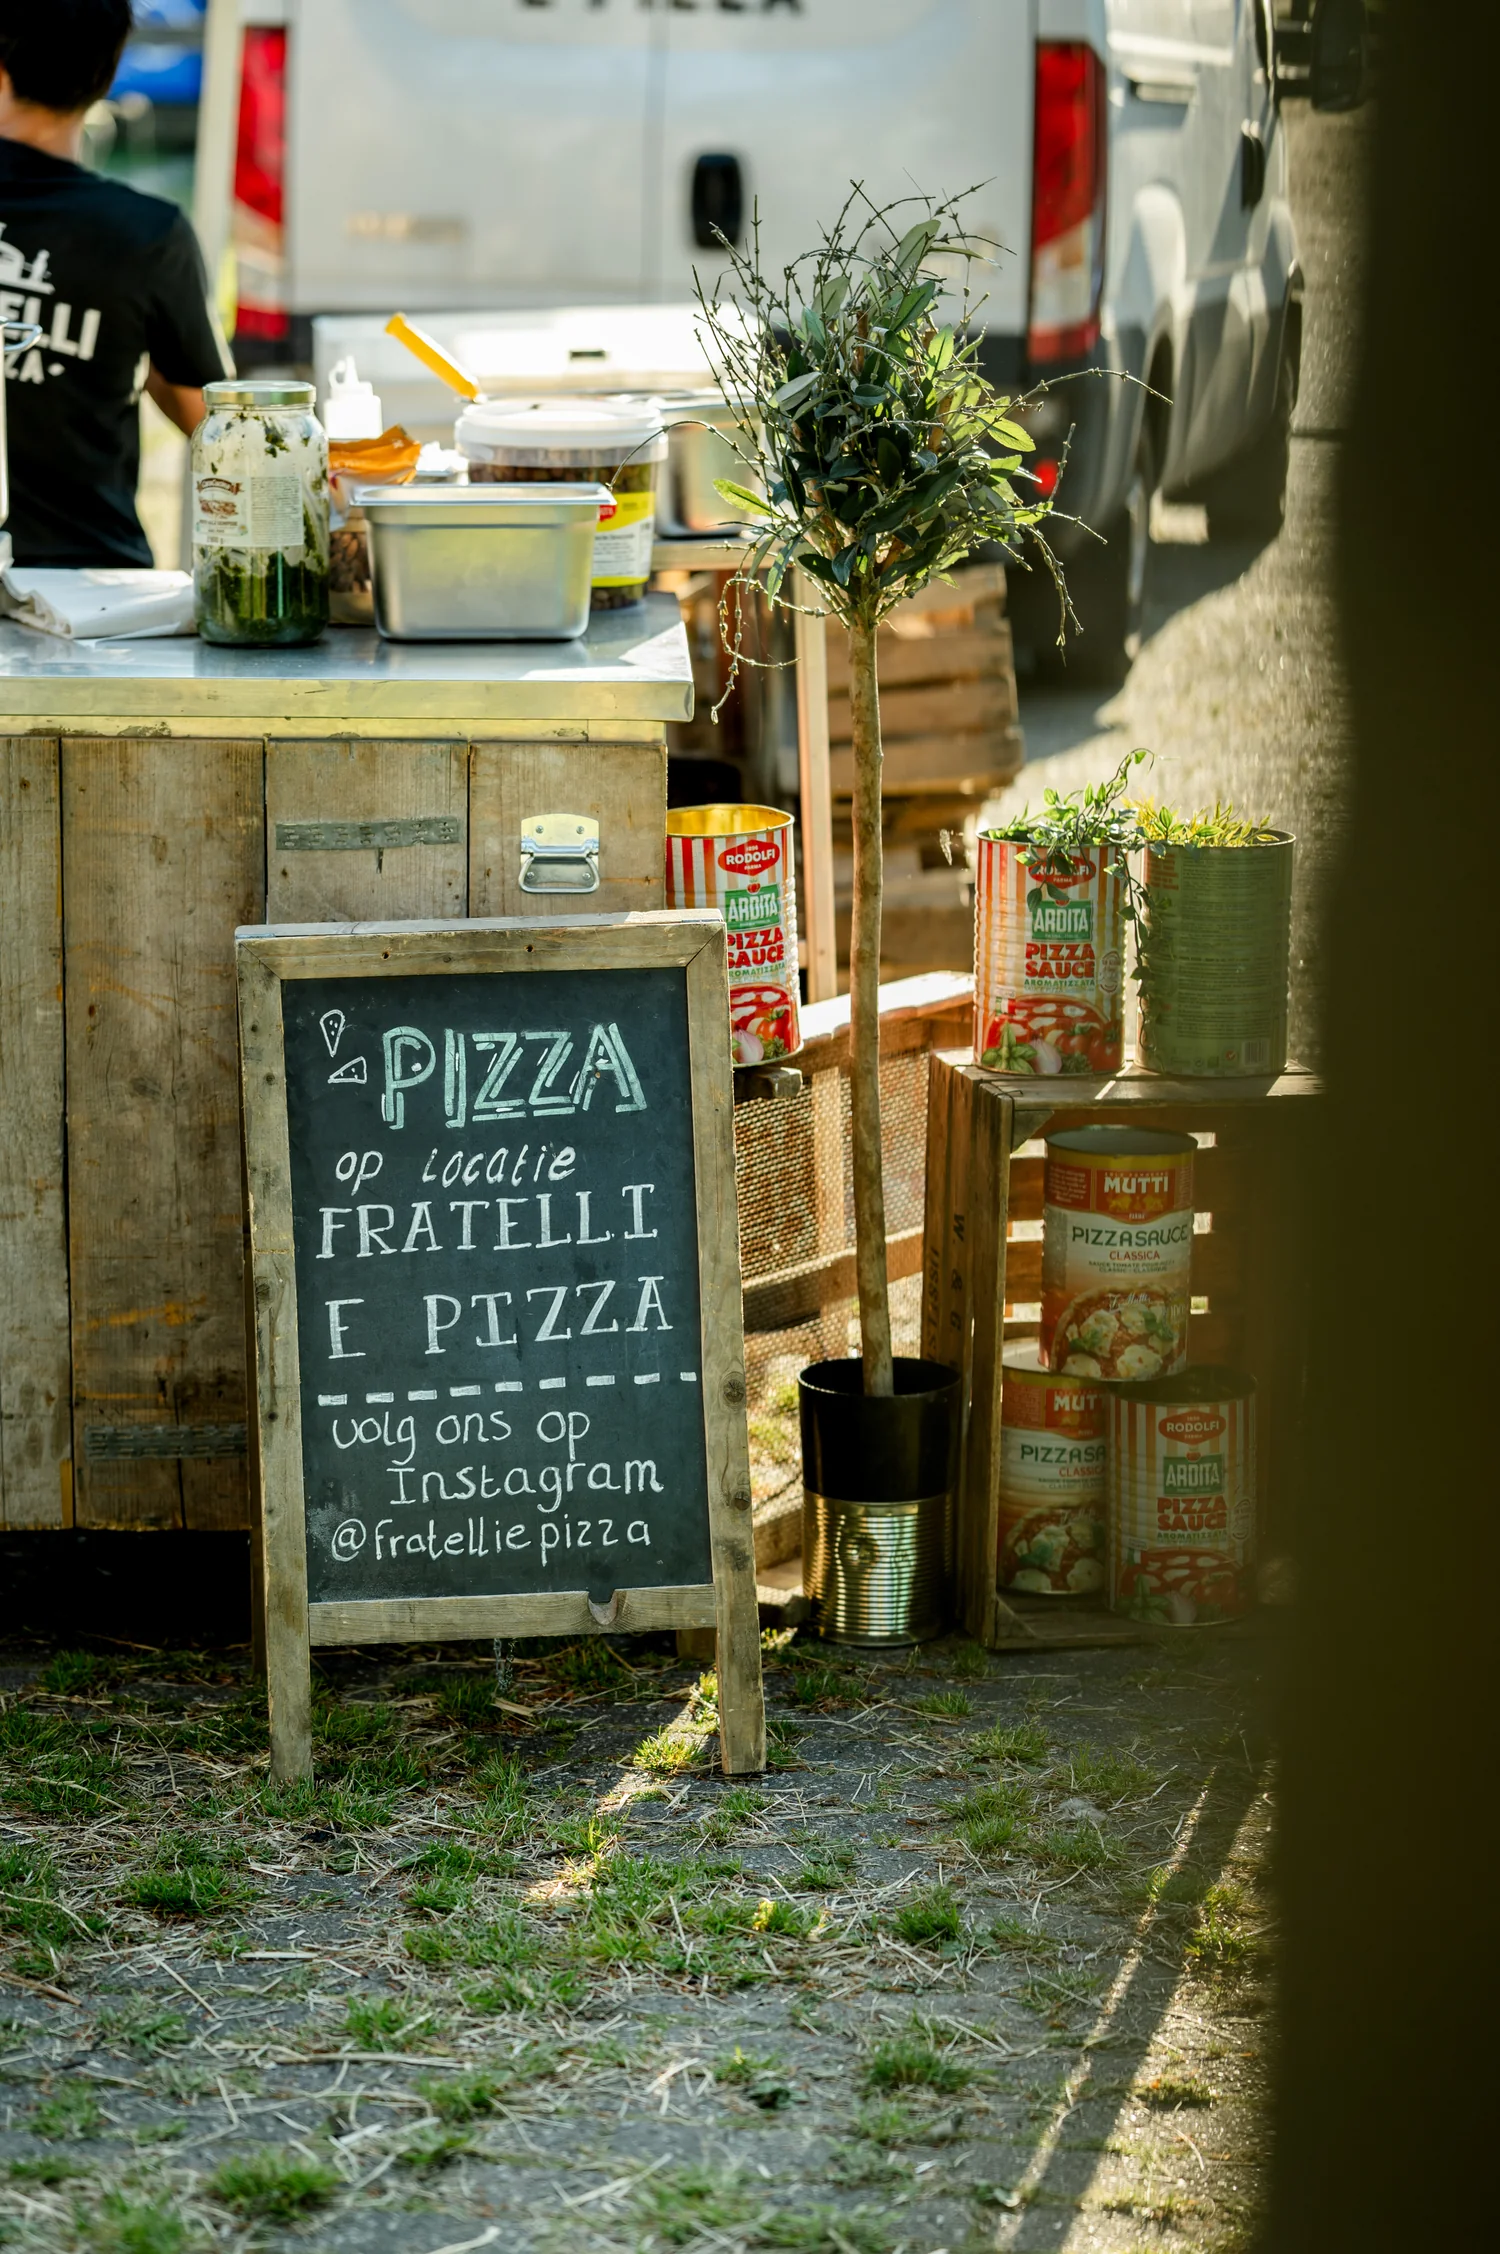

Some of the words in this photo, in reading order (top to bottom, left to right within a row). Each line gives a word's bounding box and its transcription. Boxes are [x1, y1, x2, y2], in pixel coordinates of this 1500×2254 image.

[726, 848, 776, 865] RODOLFI
[728, 893, 777, 922] ARDITA
[1034, 908, 1088, 933] ARDITA
[727, 927, 784, 950] PIZZA
[728, 944, 784, 970] SAUCE
[1025, 943, 1095, 960] PIZZA
[729, 962, 785, 977] ROMATIZZATA
[1025, 961, 1095, 979] SAUCE
[1024, 978, 1095, 986] AROMATIZZATA
[382, 1022, 647, 1129] PIZZA
[335, 1150, 383, 1195] op
[1104, 1176, 1168, 1194] MUTTI
[316, 1184, 658, 1259] FRATELLI
[1072, 1224, 1188, 1247] PIZZASAUCE
[1109, 1250, 1160, 1260] CLASSICA
[325, 1298, 366, 1359] E
[423, 1276, 673, 1354] PIZZA
[1054, 1394, 1106, 1412] MUT
[1166, 1420, 1219, 1432] RODOLFI
[332, 1412, 416, 1465] volg
[436, 1411, 512, 1445] ons
[536, 1411, 590, 1462] op
[1166, 1462, 1220, 1487] ARDITA
[386, 1459, 663, 1514] Instagram
[1157, 1495, 1227, 1514] PIZZA
[1158, 1512, 1227, 1532] SAUCE
[331, 1513, 652, 1567] @fratelliepizza
